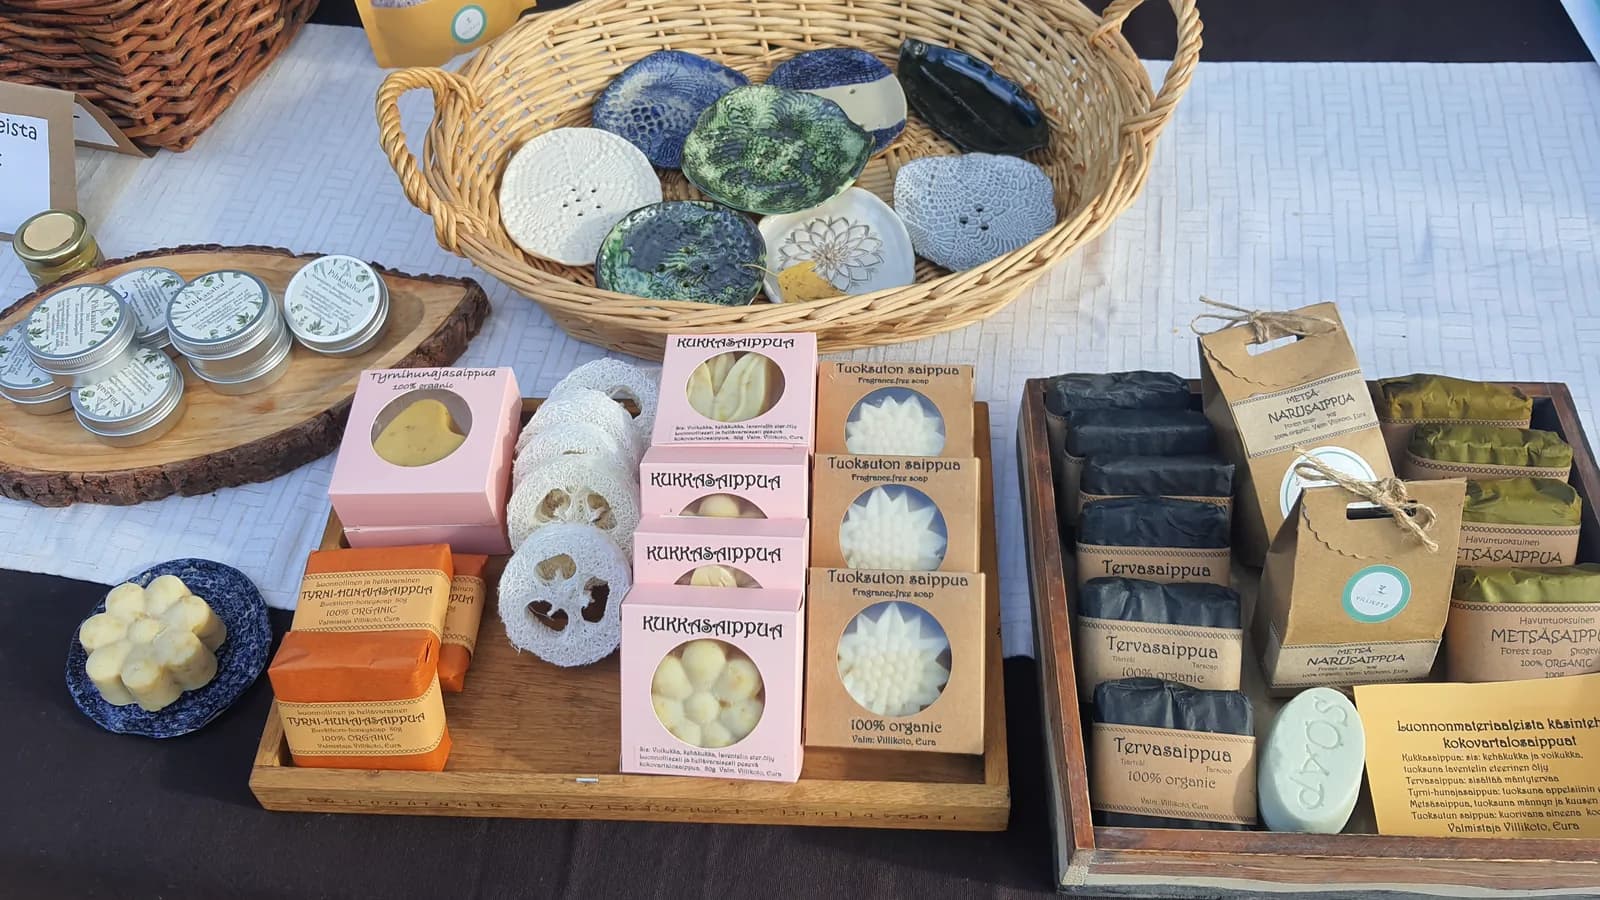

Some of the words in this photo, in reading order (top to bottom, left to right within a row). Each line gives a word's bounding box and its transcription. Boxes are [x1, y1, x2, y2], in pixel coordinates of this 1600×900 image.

[676, 337, 795, 349] KUKKASAIPPUA
[370, 367, 496, 385] Tyrnihunajasaippua
[836, 362, 904, 374] Tuoksuton
[907, 364, 960, 377] saippua
[392, 382, 417, 391] 100%
[418, 382, 455, 390] organic
[1267, 393, 1356, 424] NARUSAIPPUA
[827, 456, 901, 470] Tuoksuton
[904, 459, 961, 473] saippua
[651, 472, 781, 490] KUKKASAIPPUA
[909, 475, 929, 483] soap
[1465, 535, 1541, 546] Havuntuoksuinen
[646, 545, 782, 563] KUKKASAIPPUA
[1101, 559, 1212, 579] Tervasaippua
[827, 568, 905, 585] Tuoksuton
[908, 573, 969, 588] saippua
[301, 585, 433, 602] TYRNI-HUNAJASAIPPUA
[913, 590, 934, 599] soap
[326, 608, 350, 617] 100%
[350, 604, 398, 616] ORGANIC
[642, 615, 784, 640] KUKKASAIPPUA
[1519, 616, 1595, 625] Havuntuoksuinen
[1491, 627, 1600, 645] METSÄSAIPP
[1105, 635, 1219, 660] Tervasaippua
[1500, 646, 1530, 656] Forest
[1532, 647, 1552, 656] soap
[1306, 654, 1406, 666] NARUSAIPPUA
[1520, 659, 1543, 667] 100%
[1544, 658, 1593, 668] ORGANIC
[1121, 667, 1153, 678] 100%
[1156, 670, 1205, 684] organic
[286, 712, 426, 727] TYRNI-HUNAJASAIPPUA
[1397, 719, 1544, 733] Luonnonmateriaaleista
[851, 718, 886, 732] 100%
[888, 720, 943, 736] organic
[321, 734, 346, 743] 100%
[347, 733, 395, 743] ORGANIC
[876, 735, 914, 746] Villikoto,
[915, 737, 936, 746] Eura
[1443, 735, 1577, 750] kokovartalosaippuat
[1113, 736, 1232, 764] Tervasaippua
[1289, 695, 1348, 810] SOAP
[1401, 753, 1464, 763] Kukkasaippua:
[1466, 753, 1481, 761] sis:
[1482, 752, 1529, 761] kehäkukka
[1530, 752, 1540, 761] ja
[1403, 765, 1444, 774] tuoksuna
[1445, 764, 1488, 774] laventelin
[1489, 764, 1530, 773] eteerinen
[1531, 763, 1549, 773] öljy
[1127, 769, 1163, 784] 100%
[1164, 775, 1217, 790] organic
[1405, 776, 1466, 786] Tervasaippua:
[1468, 776, 1503, 785] sisältää
[1504, 775, 1560, 785] mäntytervaa
[1407, 787, 1500, 798] Tyrni-hunajasaippua:
[1502, 786, 1544, 796] tuoksuna
[1545, 785, 1596, 796] appelsiinin
[1474, 797, 1515, 808] tuoksuna
[1516, 798, 1553, 808] männyn
[1554, 797, 1564, 807] ja
[1564, 796, 1598, 805] kuusen
[1459, 810, 1498, 821] saippua:
[1498, 809, 1544, 819] kuorivana
[1546, 808, 1582, 817] aineena
[1447, 822, 1501, 834] Valmistaja
[1552, 820, 1580, 831] Eura
